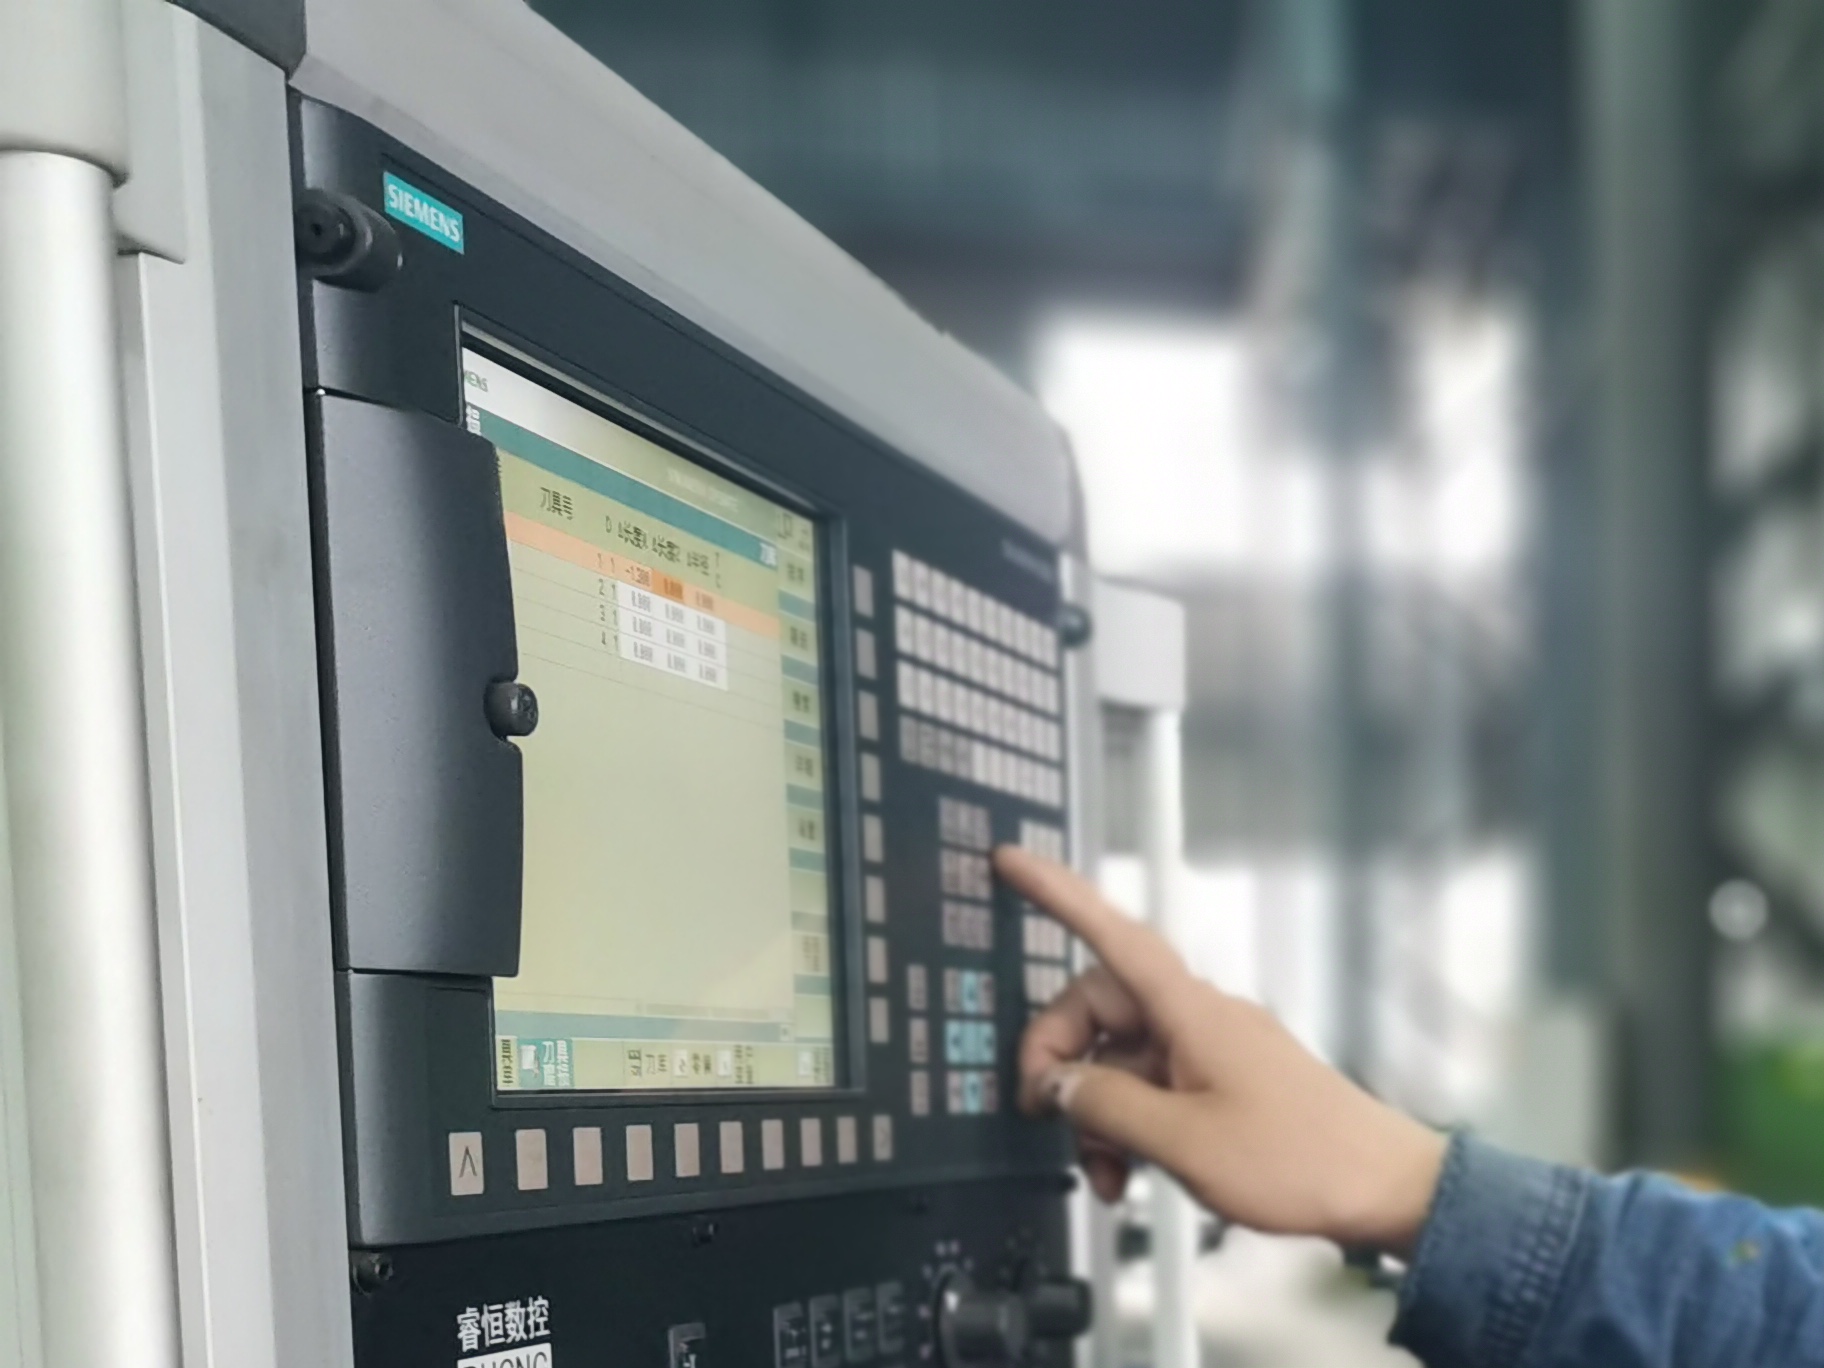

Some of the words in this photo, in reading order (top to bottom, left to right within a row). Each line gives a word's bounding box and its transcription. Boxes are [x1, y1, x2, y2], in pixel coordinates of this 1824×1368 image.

[388, 184, 461, 242] SIEMENS
[457, 1295, 551, 1352] 睿恒数控
